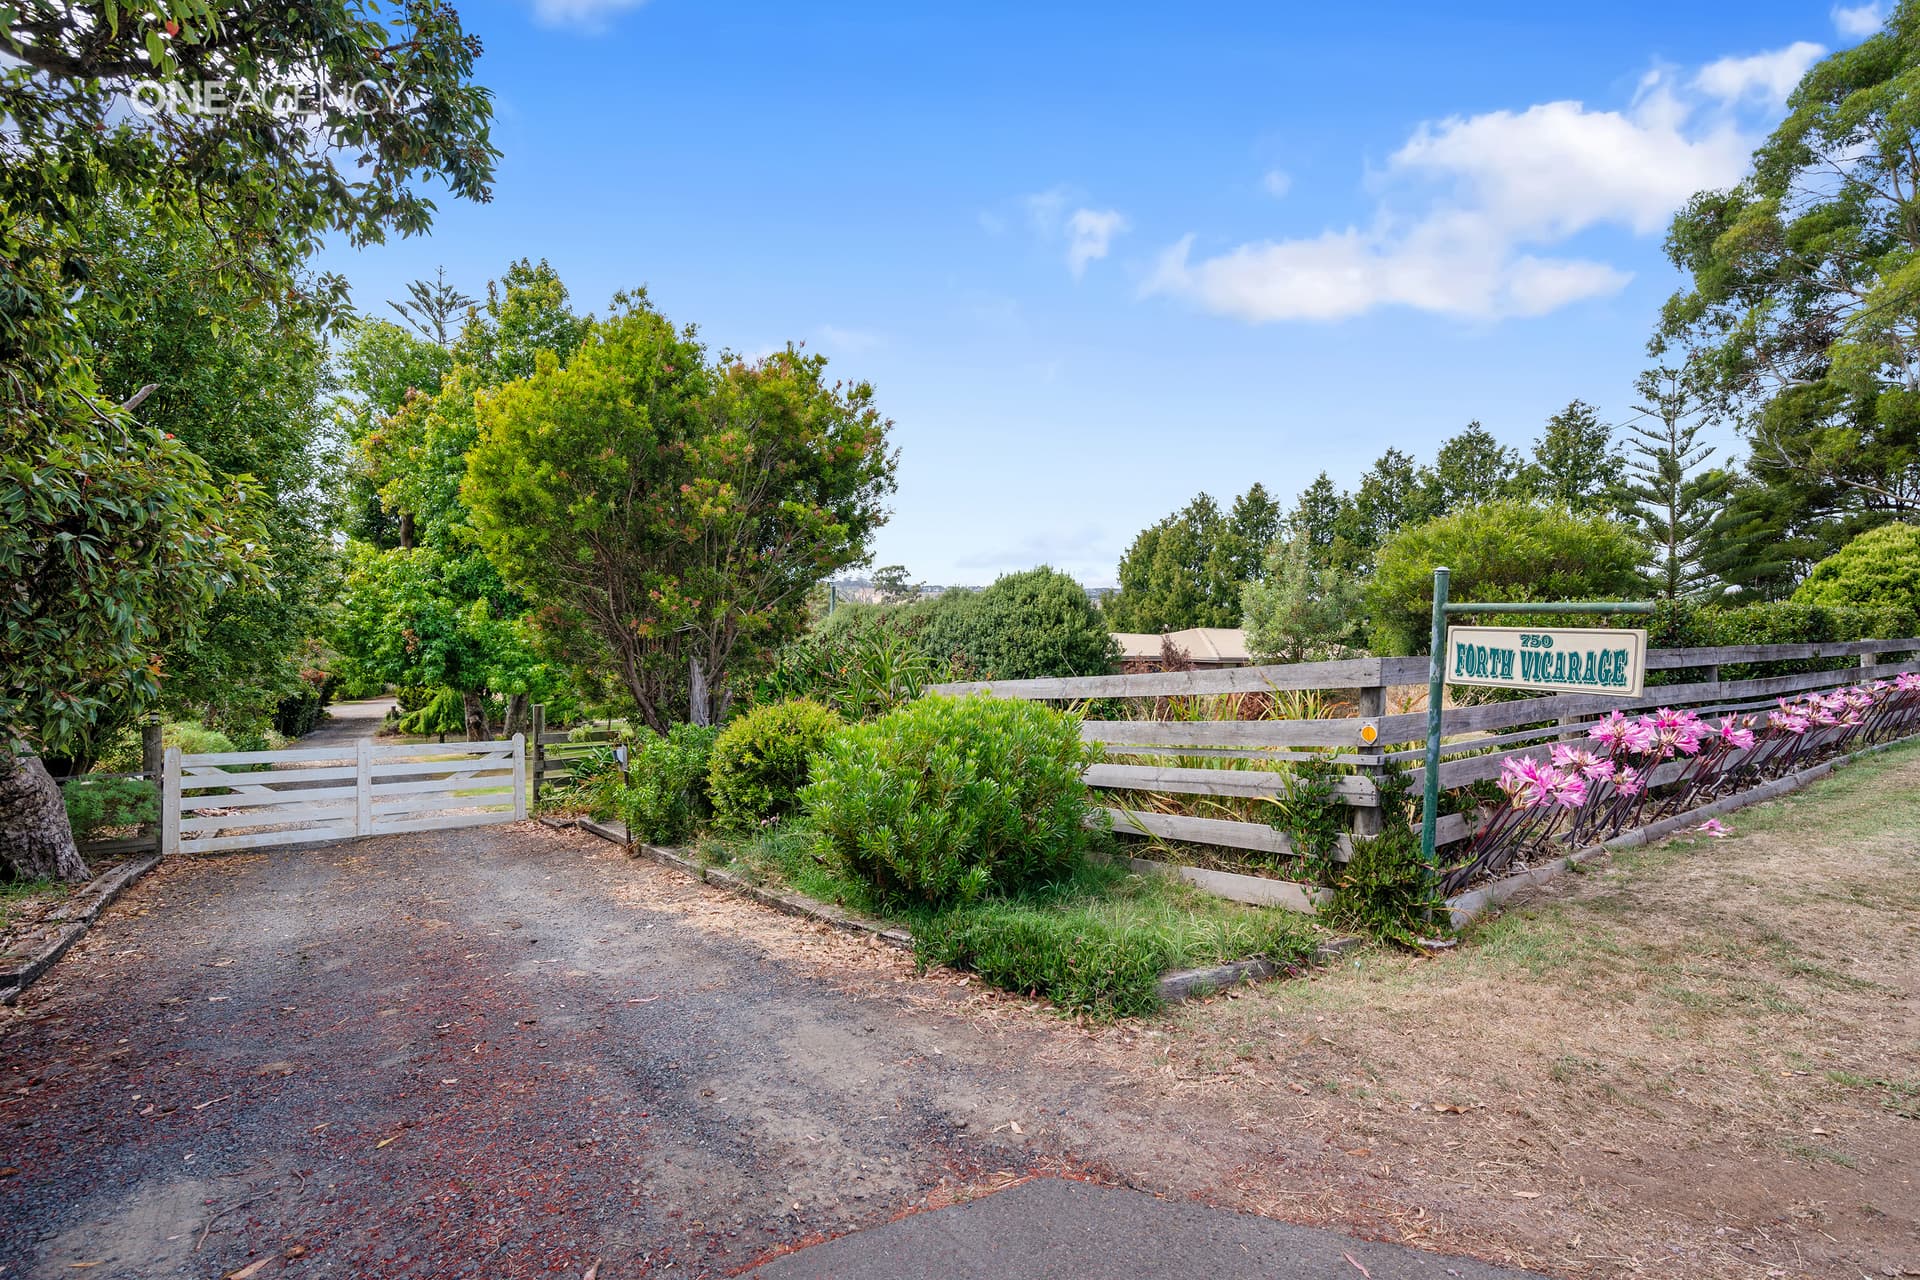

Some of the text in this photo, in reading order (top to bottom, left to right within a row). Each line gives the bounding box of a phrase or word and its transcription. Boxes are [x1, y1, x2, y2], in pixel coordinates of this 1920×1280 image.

[1520, 634, 1553, 649] 750
[1455, 641, 1629, 687] FORTH VICARAGE
